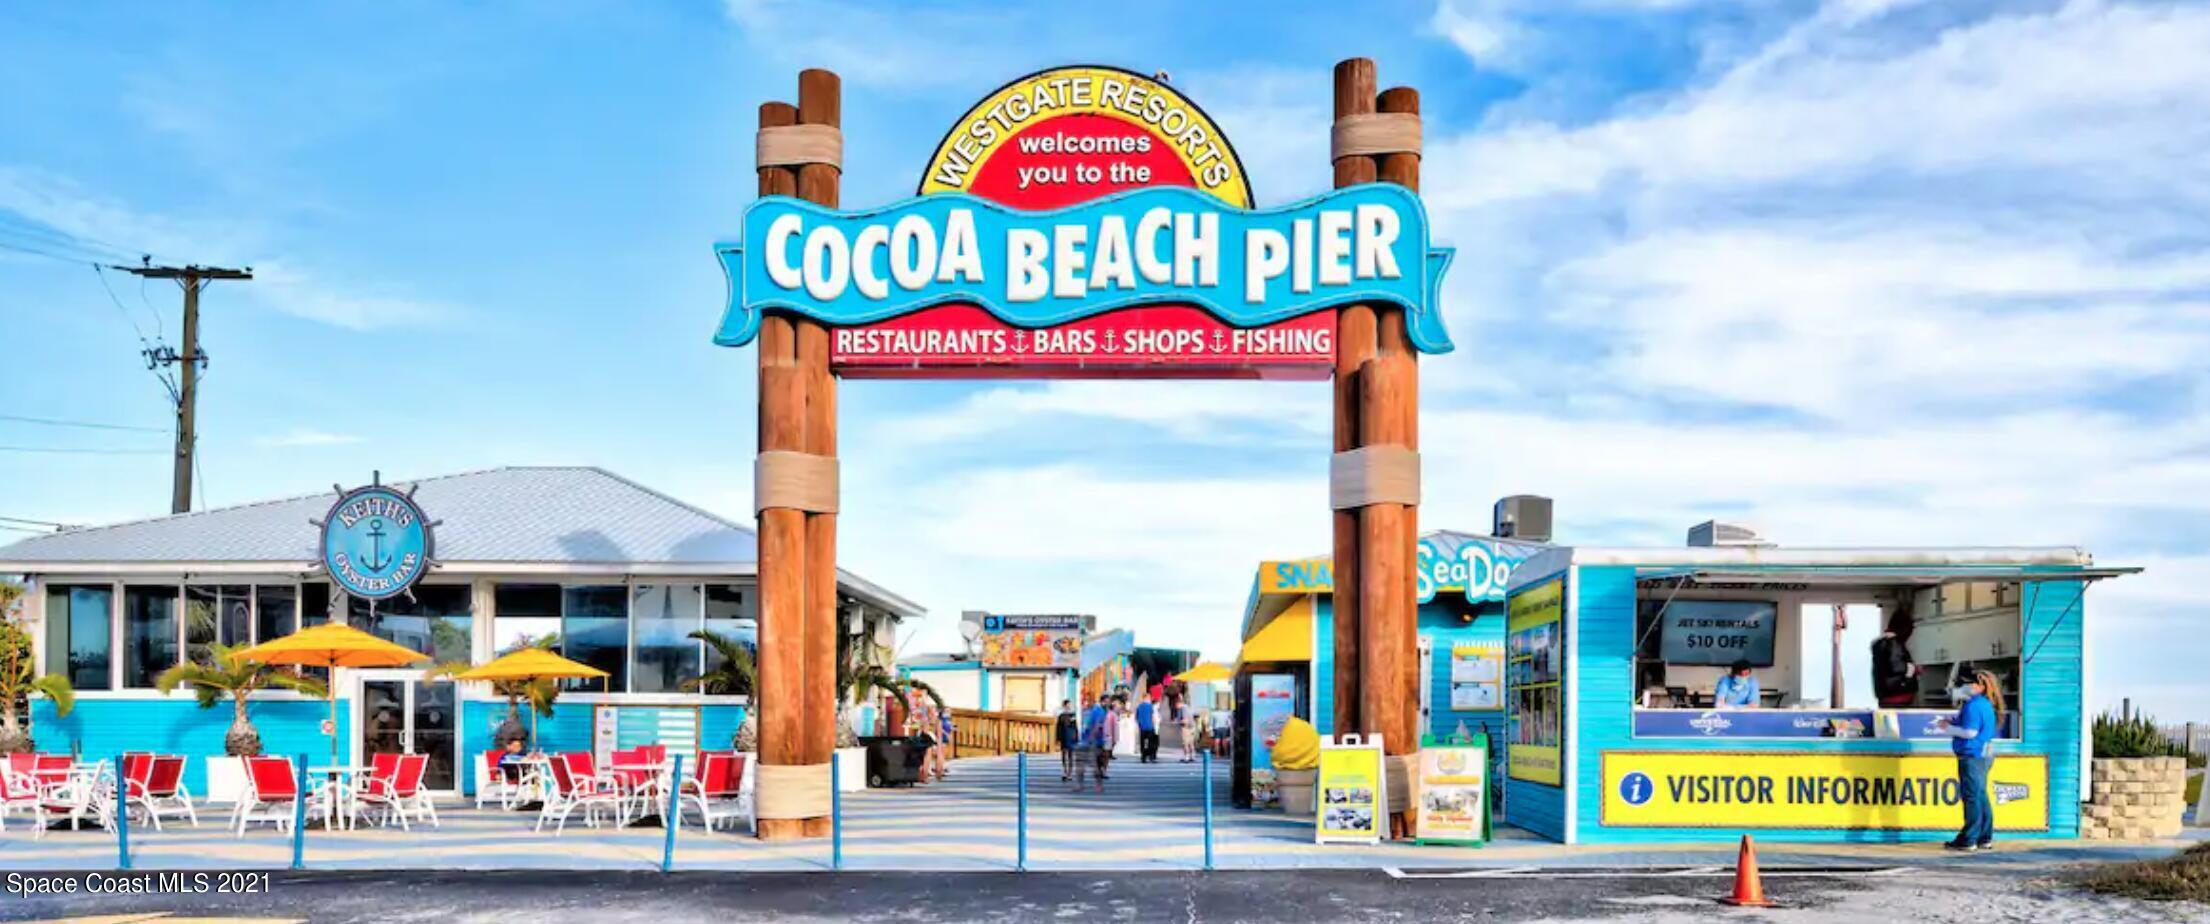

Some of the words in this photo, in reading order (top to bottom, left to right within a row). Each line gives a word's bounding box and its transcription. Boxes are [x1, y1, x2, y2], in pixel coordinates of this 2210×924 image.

[934, 76, 1092, 189] WESTGATE
[1099, 78, 1231, 189] RESORTS
[1018, 131, 1152, 155] welcomes
[1017, 165, 1068, 189] you
[1075, 164, 1103, 183] to
[1110, 162, 1151, 183] the
[765, 207, 985, 302] COCOA
[1006, 206, 1221, 303] BEACH
[1245, 203, 1402, 304] PIER
[837, 329, 1007, 355] RESTAURANTS
[1034, 329, 1096, 355] BARS
[1123, 329, 1205, 355] SHOPS
[1232, 329, 1331, 355] FISHING
[340, 497, 414, 529] KEITH'S
[335, 552, 391, 590] OYSTER
[391, 552, 416, 584] BAR
[1277, 562, 1333, 588] SNA
[1416, 541, 1521, 598] SeaDo
[1687, 633, 1714, 649] $10
[1718, 635, 1749, 649] OFF
[1667, 775, 1774, 804] VISITOR
[1786, 775, 1962, 806] INFORMATIO
